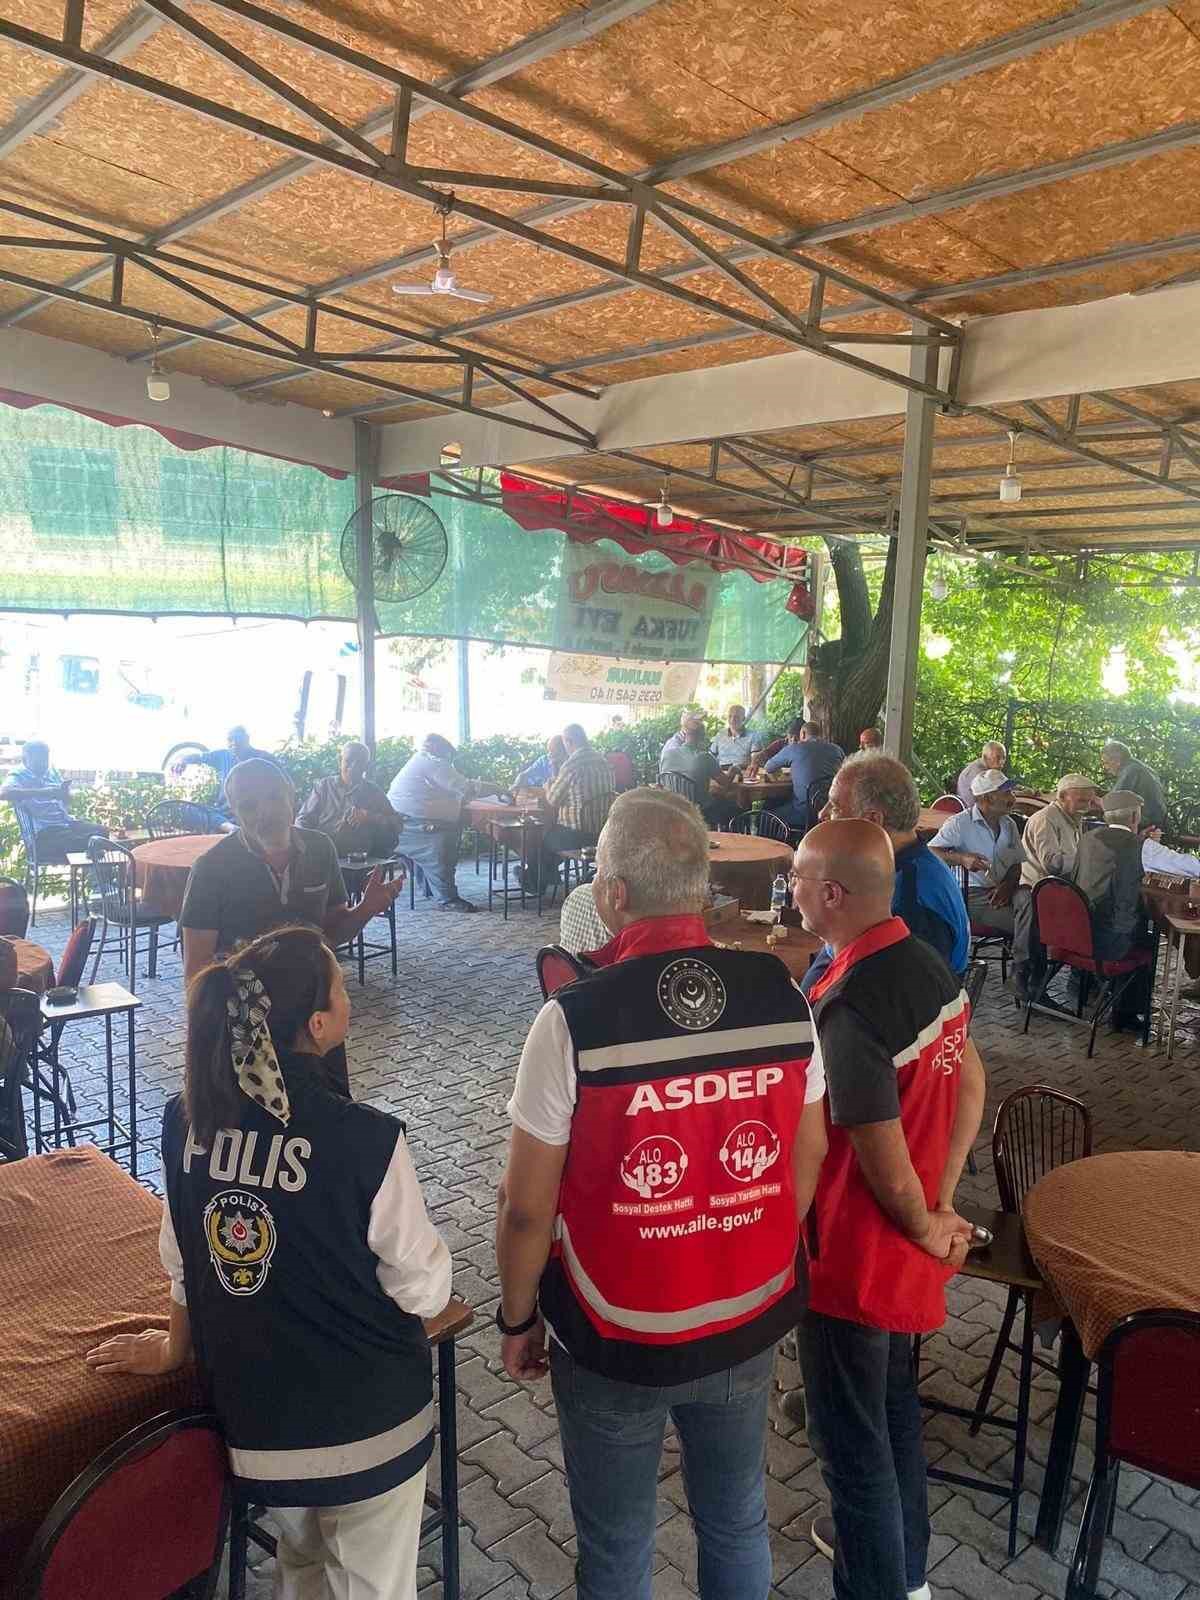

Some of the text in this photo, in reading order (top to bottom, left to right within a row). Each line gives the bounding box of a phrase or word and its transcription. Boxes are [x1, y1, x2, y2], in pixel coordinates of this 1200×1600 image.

[625, 1067, 784, 1116] ASDEP
[736, 1131, 755, 1148] ALO
[639, 1147, 661, 1163] ALO
[731, 1145, 767, 1171] 144
[632, 1161, 678, 1187] 183
[613, 1203, 641, 1215] Sosyal
[643, 1201, 673, 1213] Destek
[710, 1194, 736, 1207] Sosyal
[639, 1206, 764, 1240] www.aile.gov.tr
